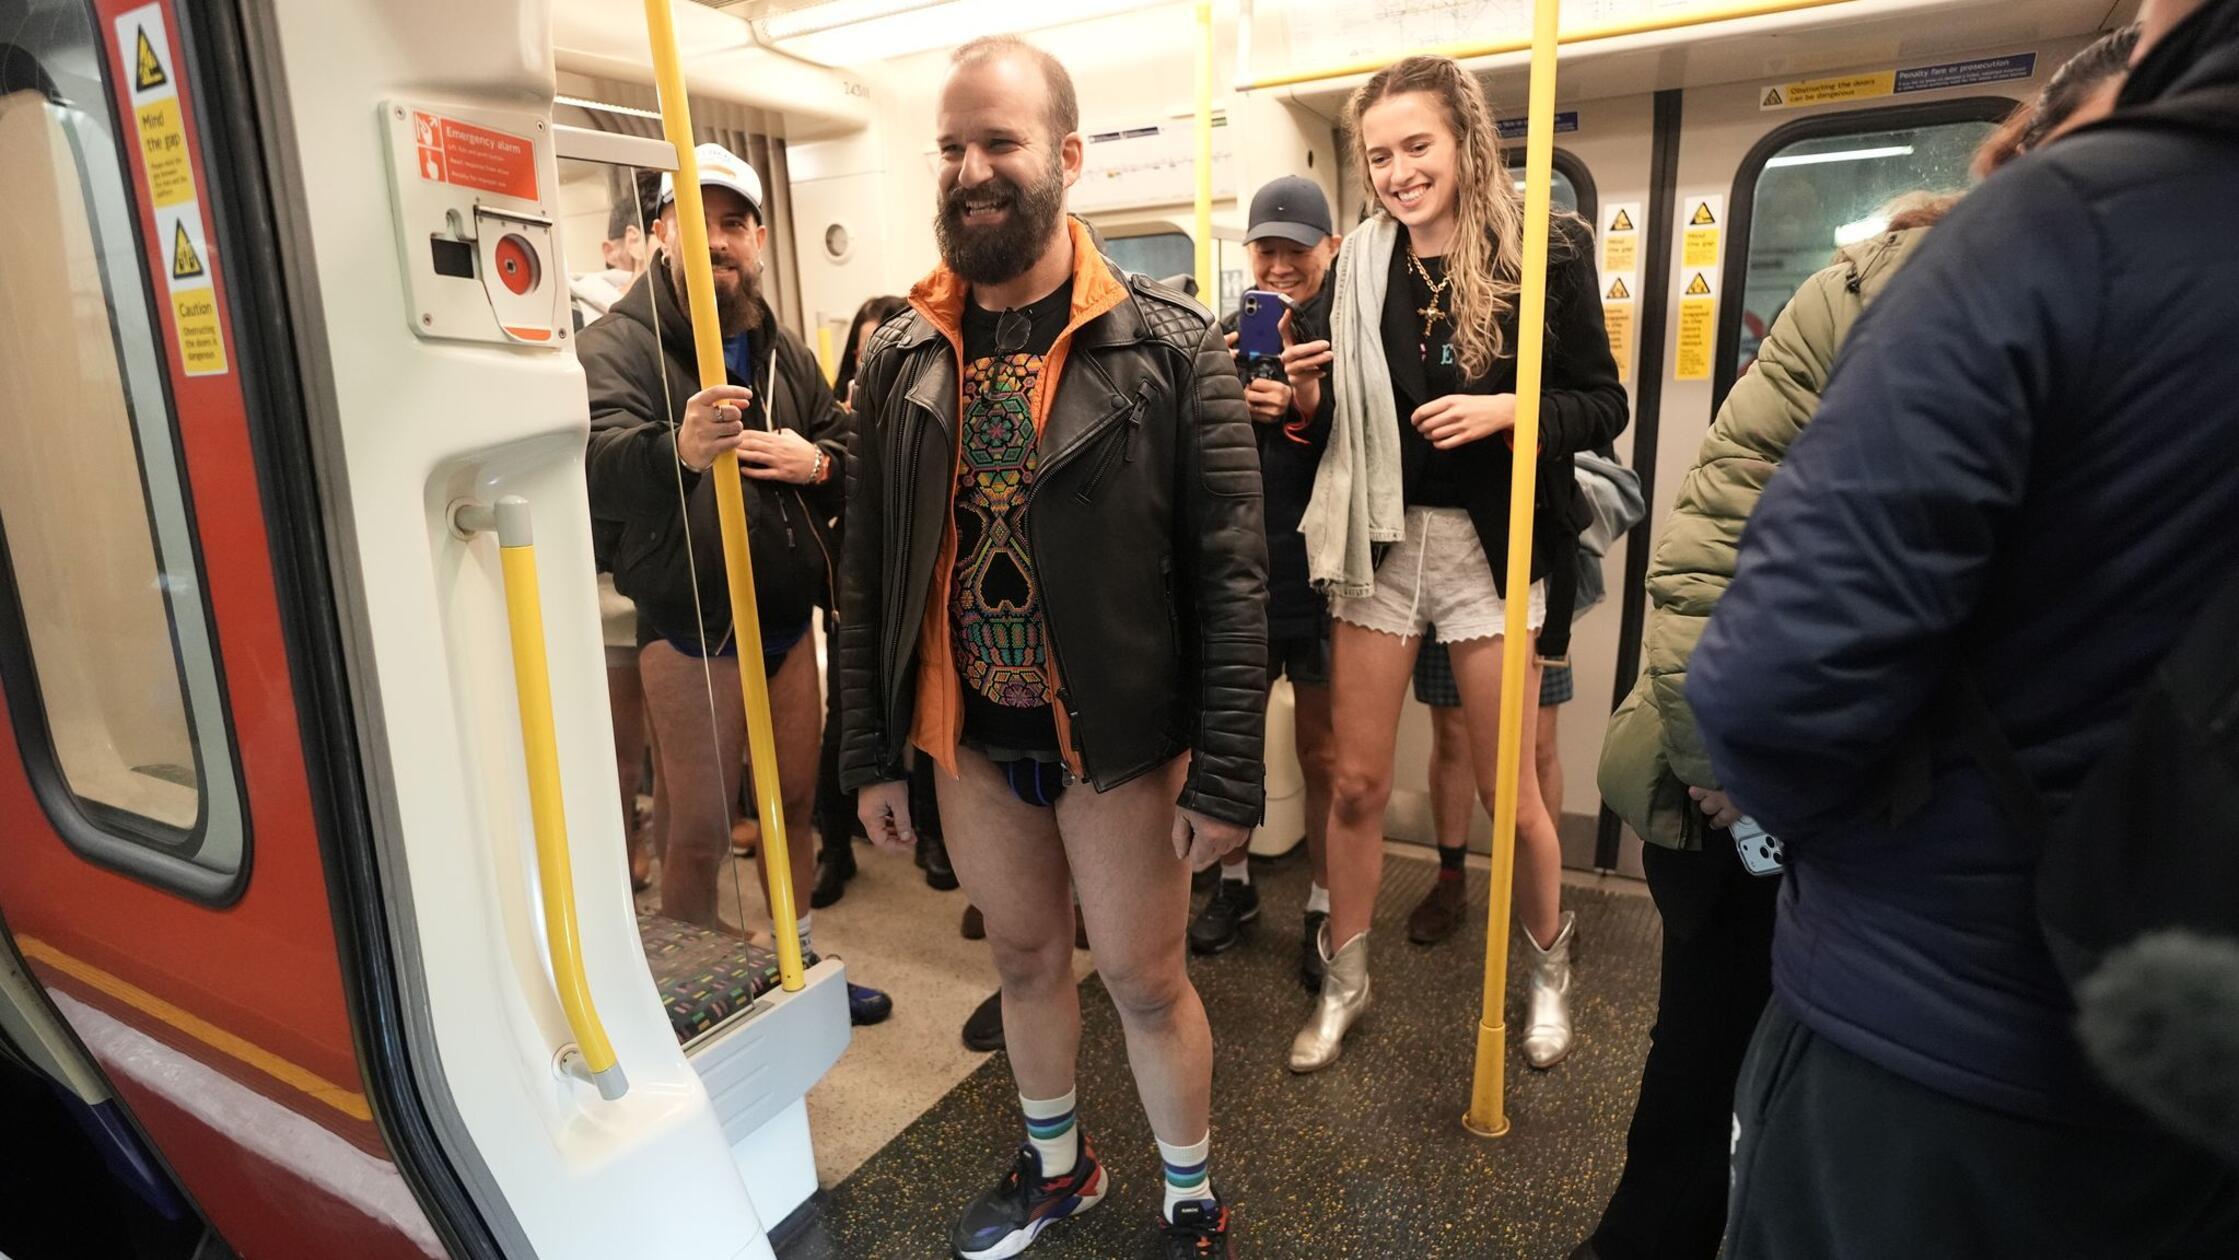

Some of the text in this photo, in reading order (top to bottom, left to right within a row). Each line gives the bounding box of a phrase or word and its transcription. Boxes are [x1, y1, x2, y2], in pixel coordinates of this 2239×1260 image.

[1899, 70, 1929, 79] Penalty
[1959, 60, 2010, 73] prosecution
[1790, 84, 1835, 95] Obstructing
[1838, 80, 1851, 89] the
[1805, 93, 1814, 101] be
[142, 110, 165, 130] Mind
[147, 133, 181, 152] the gap
[446, 126, 521, 154] Emergency alarm
[179, 302, 212, 318] Caution
